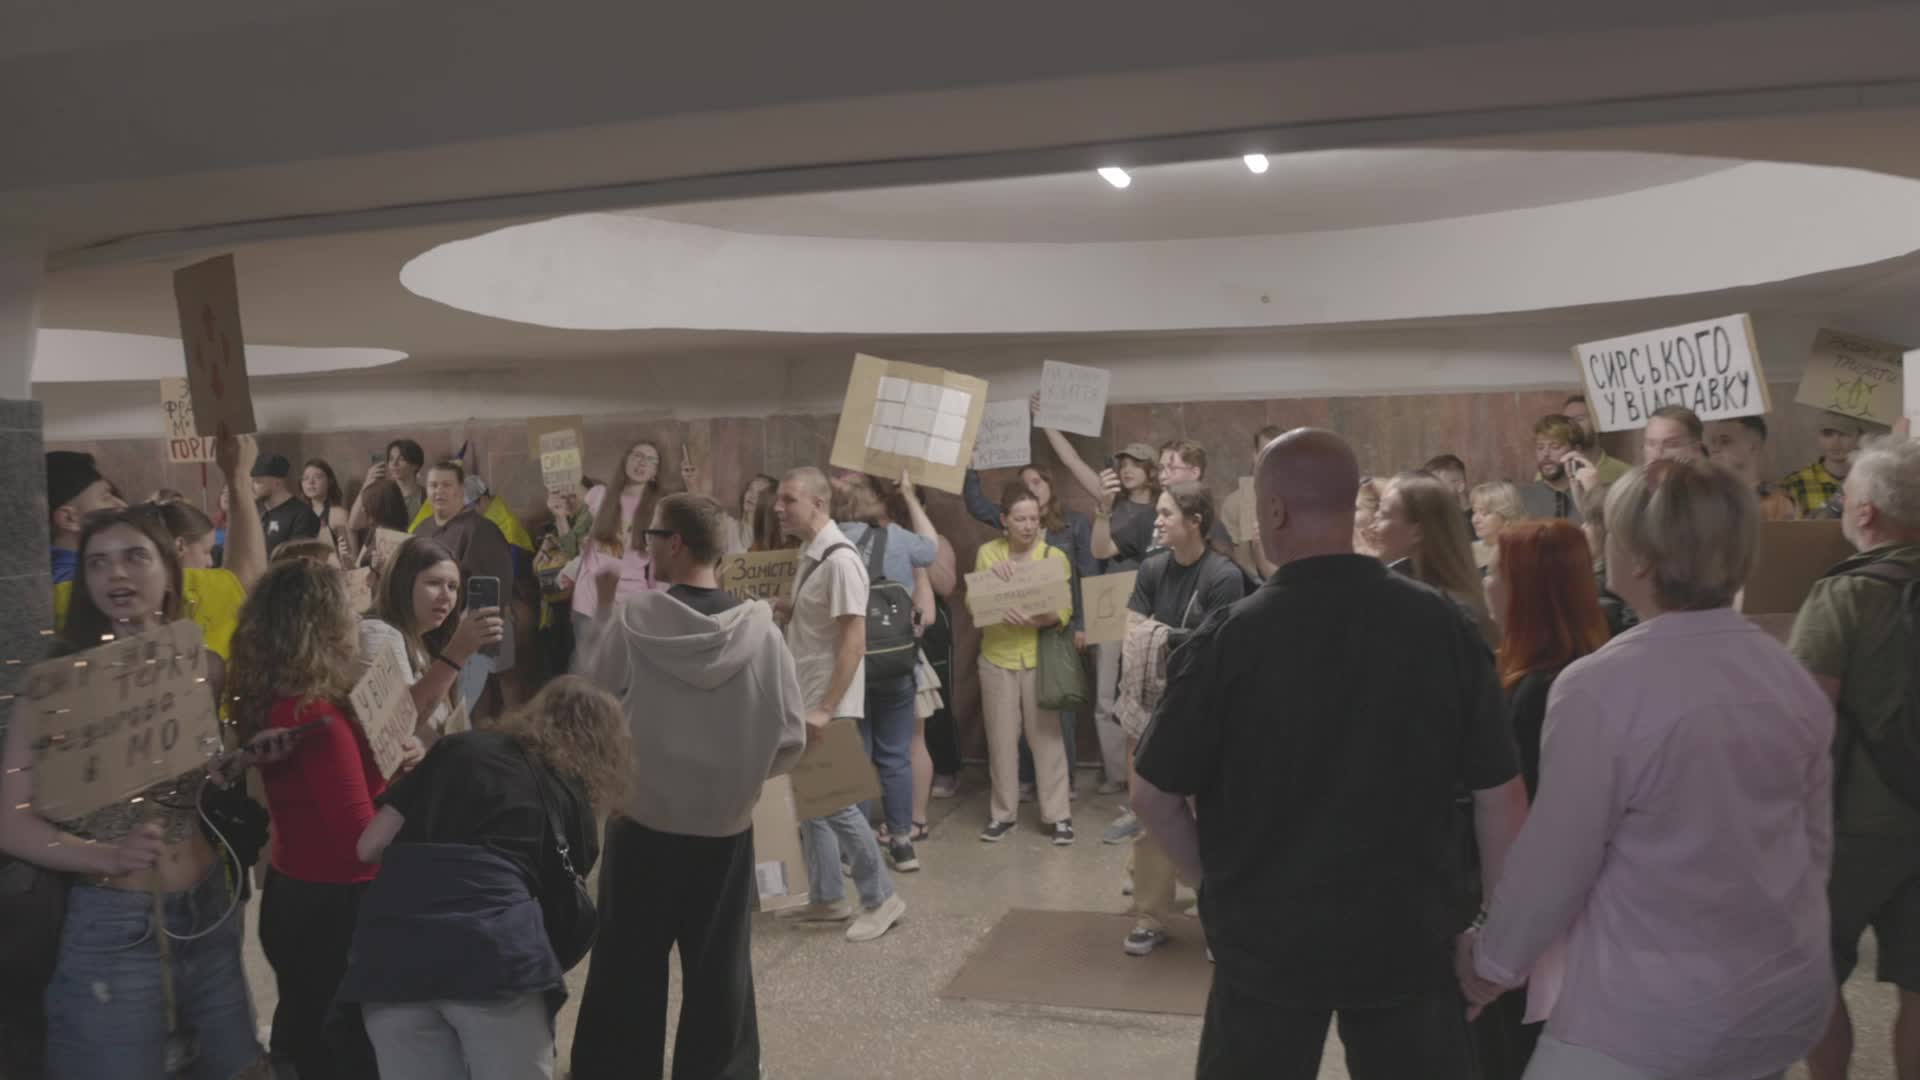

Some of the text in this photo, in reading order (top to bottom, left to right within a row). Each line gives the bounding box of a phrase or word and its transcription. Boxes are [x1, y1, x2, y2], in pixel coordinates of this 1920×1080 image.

[1589, 325, 1731, 390] СИРСЬКОГО
[1603, 370, 1749, 425] У ВІДСТАВКУ
